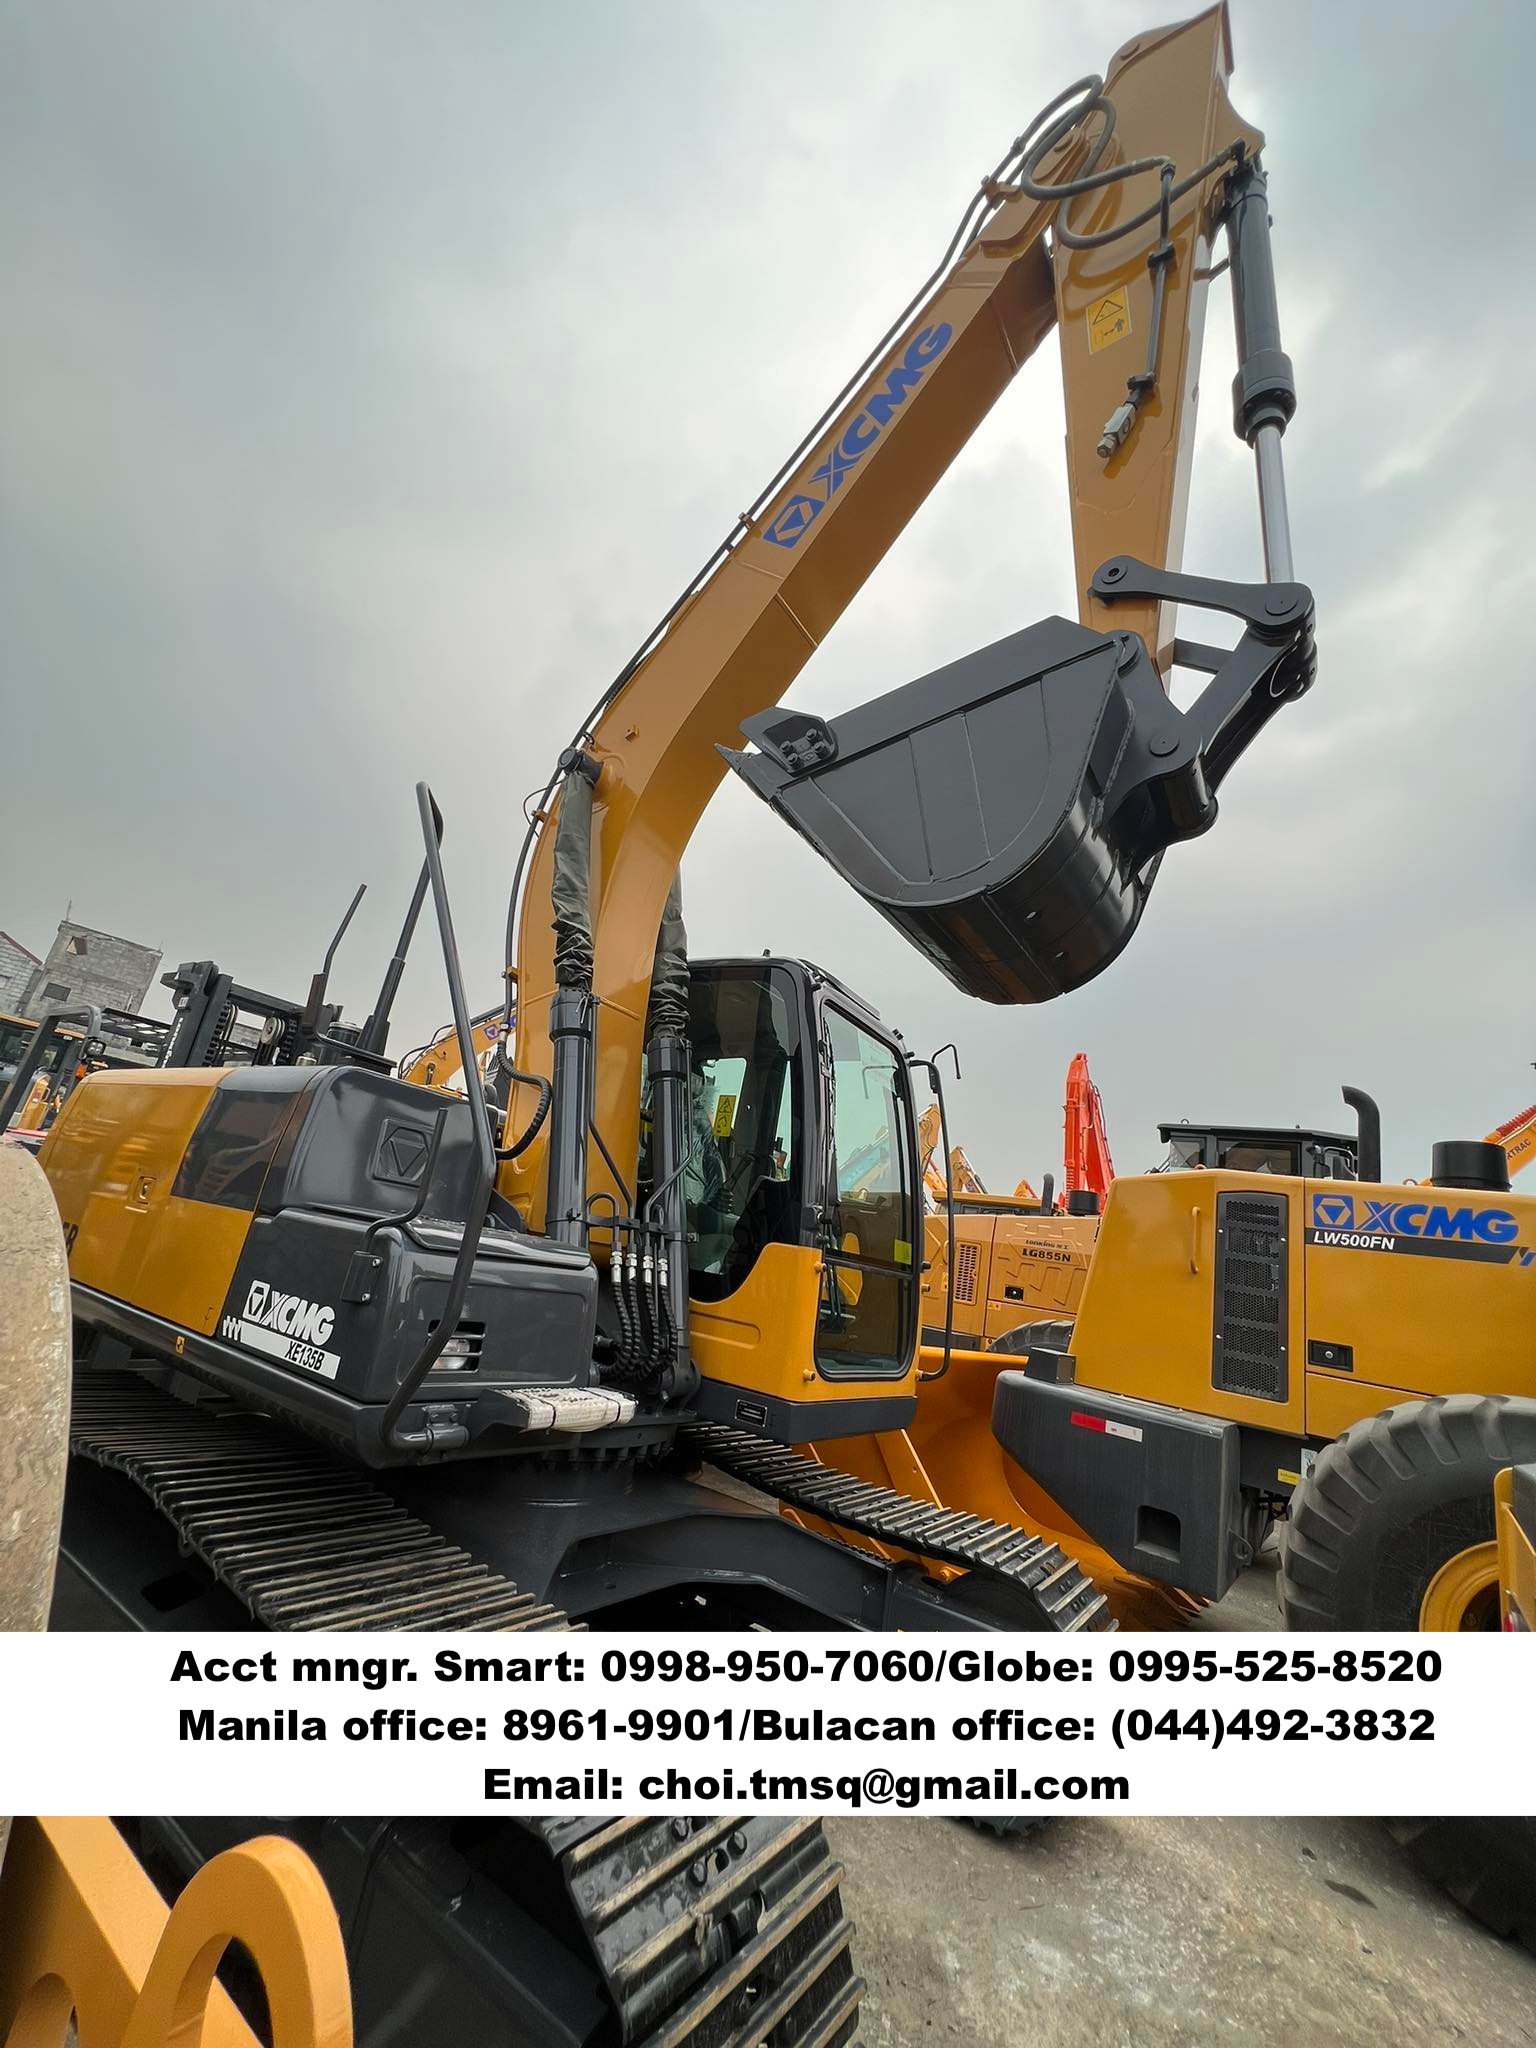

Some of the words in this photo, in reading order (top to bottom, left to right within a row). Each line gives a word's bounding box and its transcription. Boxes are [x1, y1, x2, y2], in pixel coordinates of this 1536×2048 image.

[808, 322, 953, 500] XCMG
[1355, 1201, 1519, 1243] XCMG
[1022, 1248, 1071, 1262] LG855N
[1314, 1231, 1395, 1250] LW500FN
[259, 1291, 335, 1346] XCMG
[284, 1340, 325, 1371] XE135B
